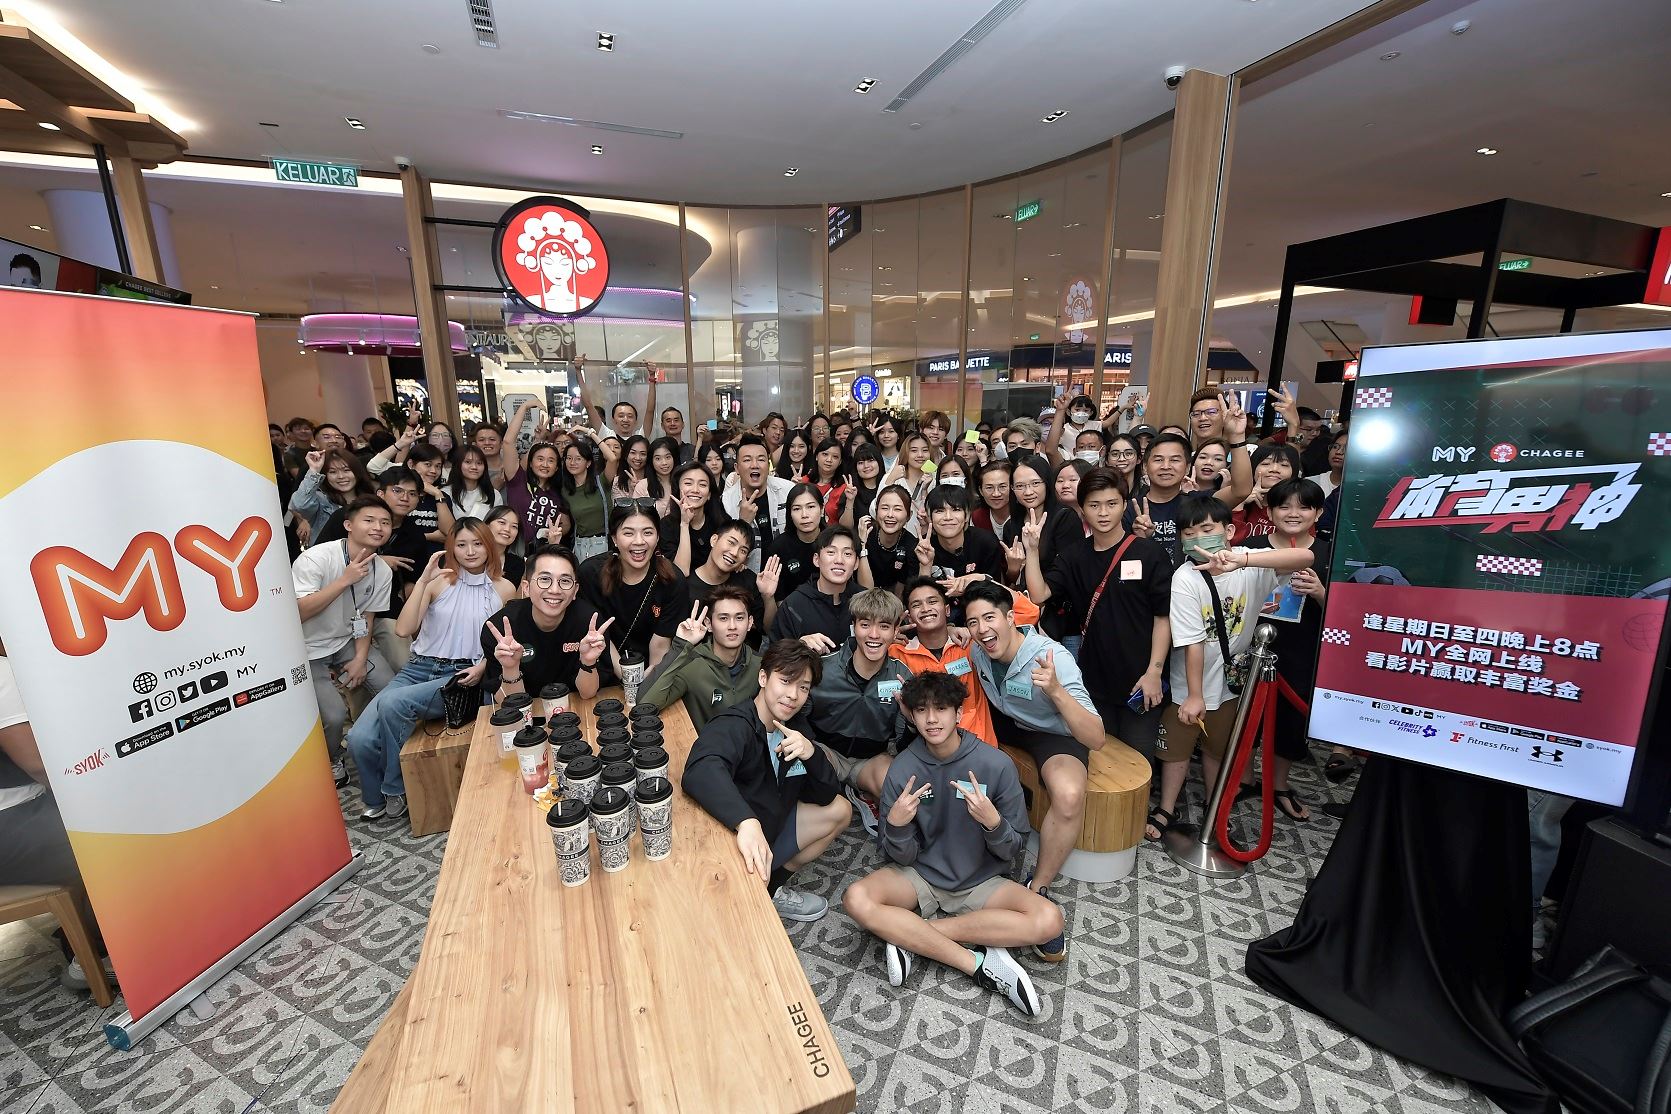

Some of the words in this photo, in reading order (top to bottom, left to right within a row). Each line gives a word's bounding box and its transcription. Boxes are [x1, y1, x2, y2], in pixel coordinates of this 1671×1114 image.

[276, 161, 341, 185] KELUAR
[929, 360, 950, 371] PARIS
[1103, 352, 1132, 364] ARIS
[1431, 446, 1476, 463] MY
[1519, 449, 1585, 459] CHAGEE
[30, 515, 273, 657] MY
[164, 645, 246, 680] my.syok.my
[1400, 637, 1543, 674] MY全网上线
[236, 663, 258, 679] MY
[1364, 650, 1583, 701] 看影片赢取丰富奖金
[250, 683, 284, 701] AppGallery
[192, 709, 215, 723] Google
[214, 704, 228, 715] Play
[1389, 719, 1423, 730] CELEBRITY
[1397, 726, 1420, 734] FITNESS
[133, 736, 150, 749] App
[150, 729, 170, 742] Store
[74, 748, 104, 776] SYOK
[787, 1001, 830, 1078] CHAGEE
